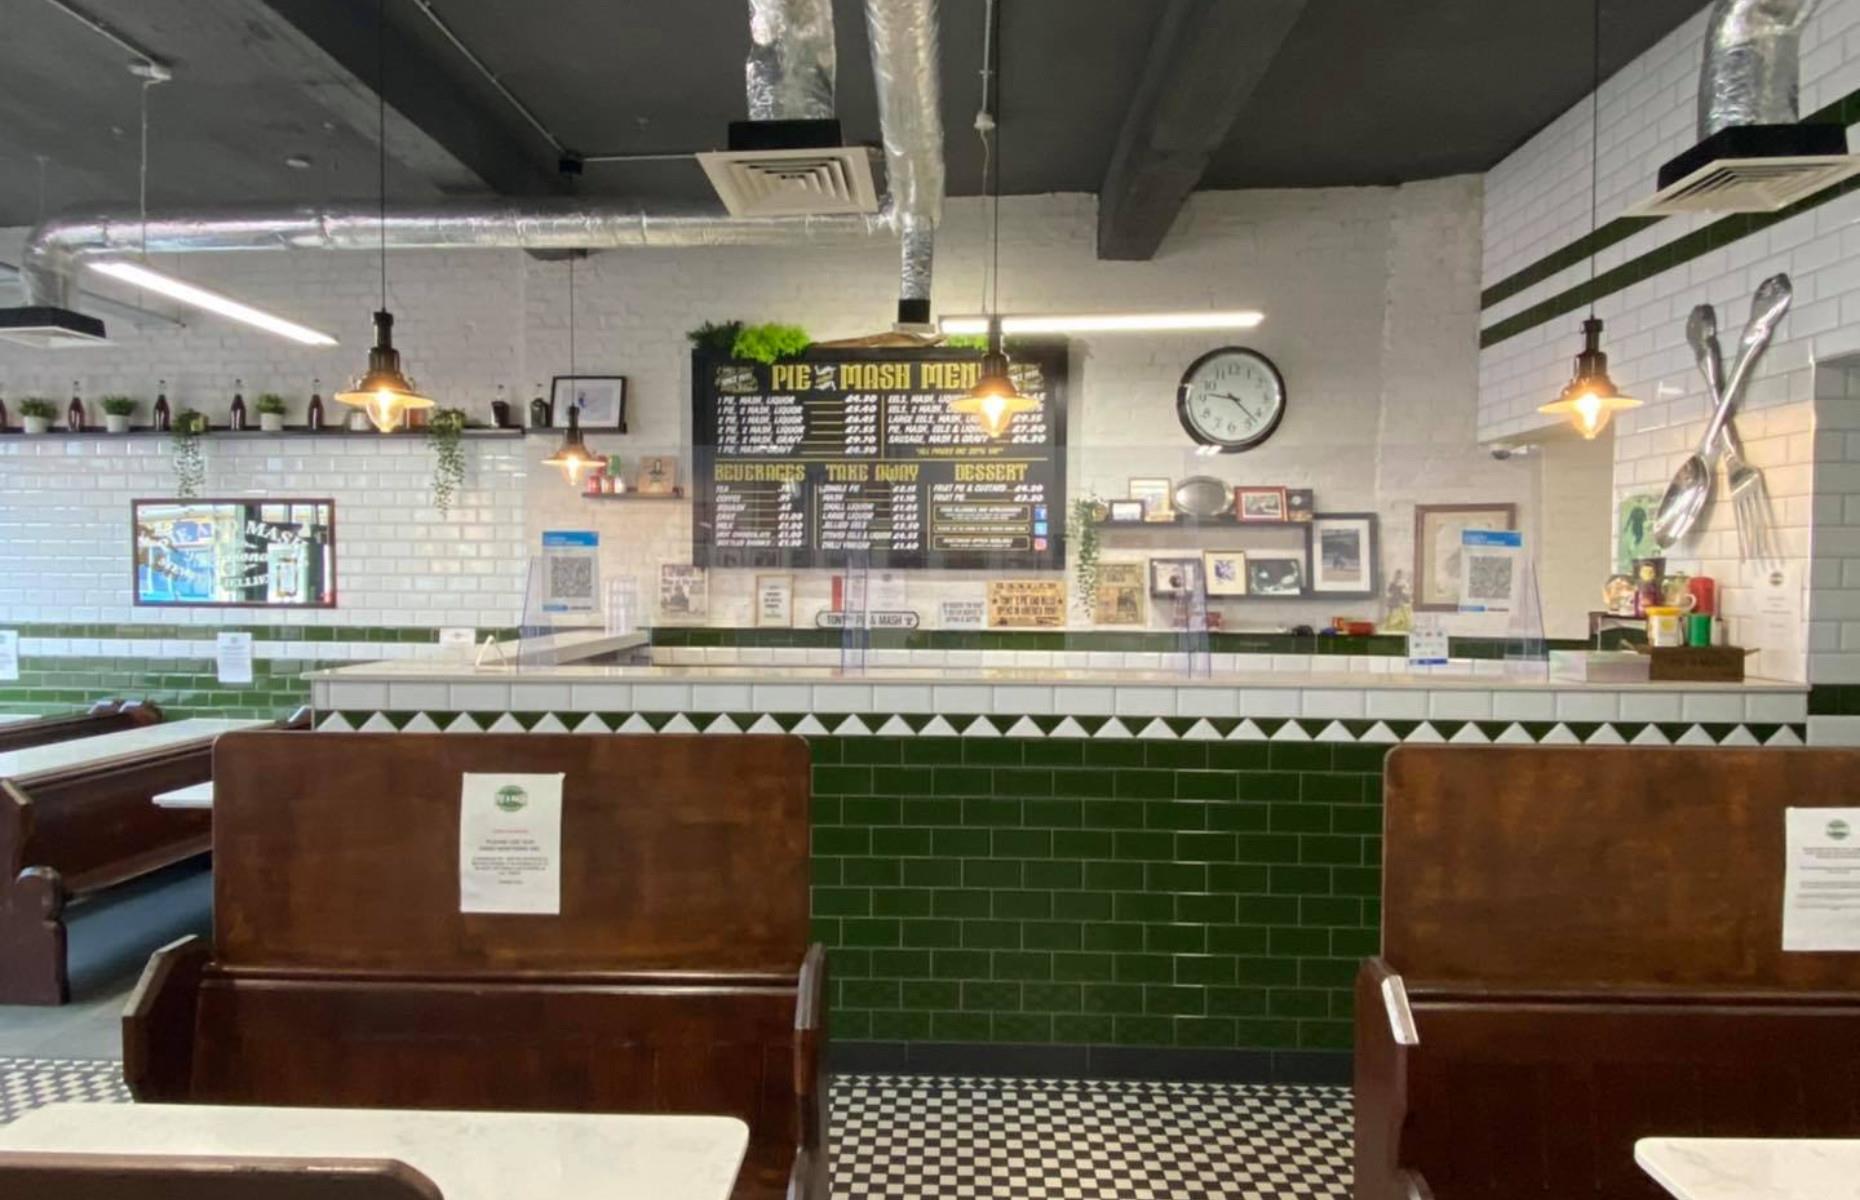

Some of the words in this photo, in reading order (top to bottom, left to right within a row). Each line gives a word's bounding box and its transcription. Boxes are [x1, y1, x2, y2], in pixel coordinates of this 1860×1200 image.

[1228, 363, 1240, 375] 12
[772, 363, 811, 390] PIE
[840, 363, 911, 390] MASH
[921, 363, 982, 390] MEN
[1204, 380, 1217, 391] 10
[766, 395, 795, 405] LIQUOR
[774, 405, 803, 415] LIQUOR
[774, 415, 803, 425] LIQUOR
[888, 414, 913, 424] LARGE
[776, 425, 805, 435] LIQUOR
[932, 424, 951, 434] EELS
[952, 424, 959, 434] &
[928, 434, 952, 444] MASH
[952, 434, 959, 444] &
[961, 434, 989, 444] GRAVY
[714, 463, 806, 481] BEVERAGES
[825, 463, 868, 481] TAKE
[875, 463, 919, 481] AWAY
[955, 463, 1028, 481] DESSERT
[954, 484, 966, 492] PIE
[966, 484, 973, 492] &
[716, 494, 741, 502] COFFEE
[954, 493, 966, 502] PIE
[822, 512, 846, 520] LARGE
[879, 614, 902, 626] MASH
